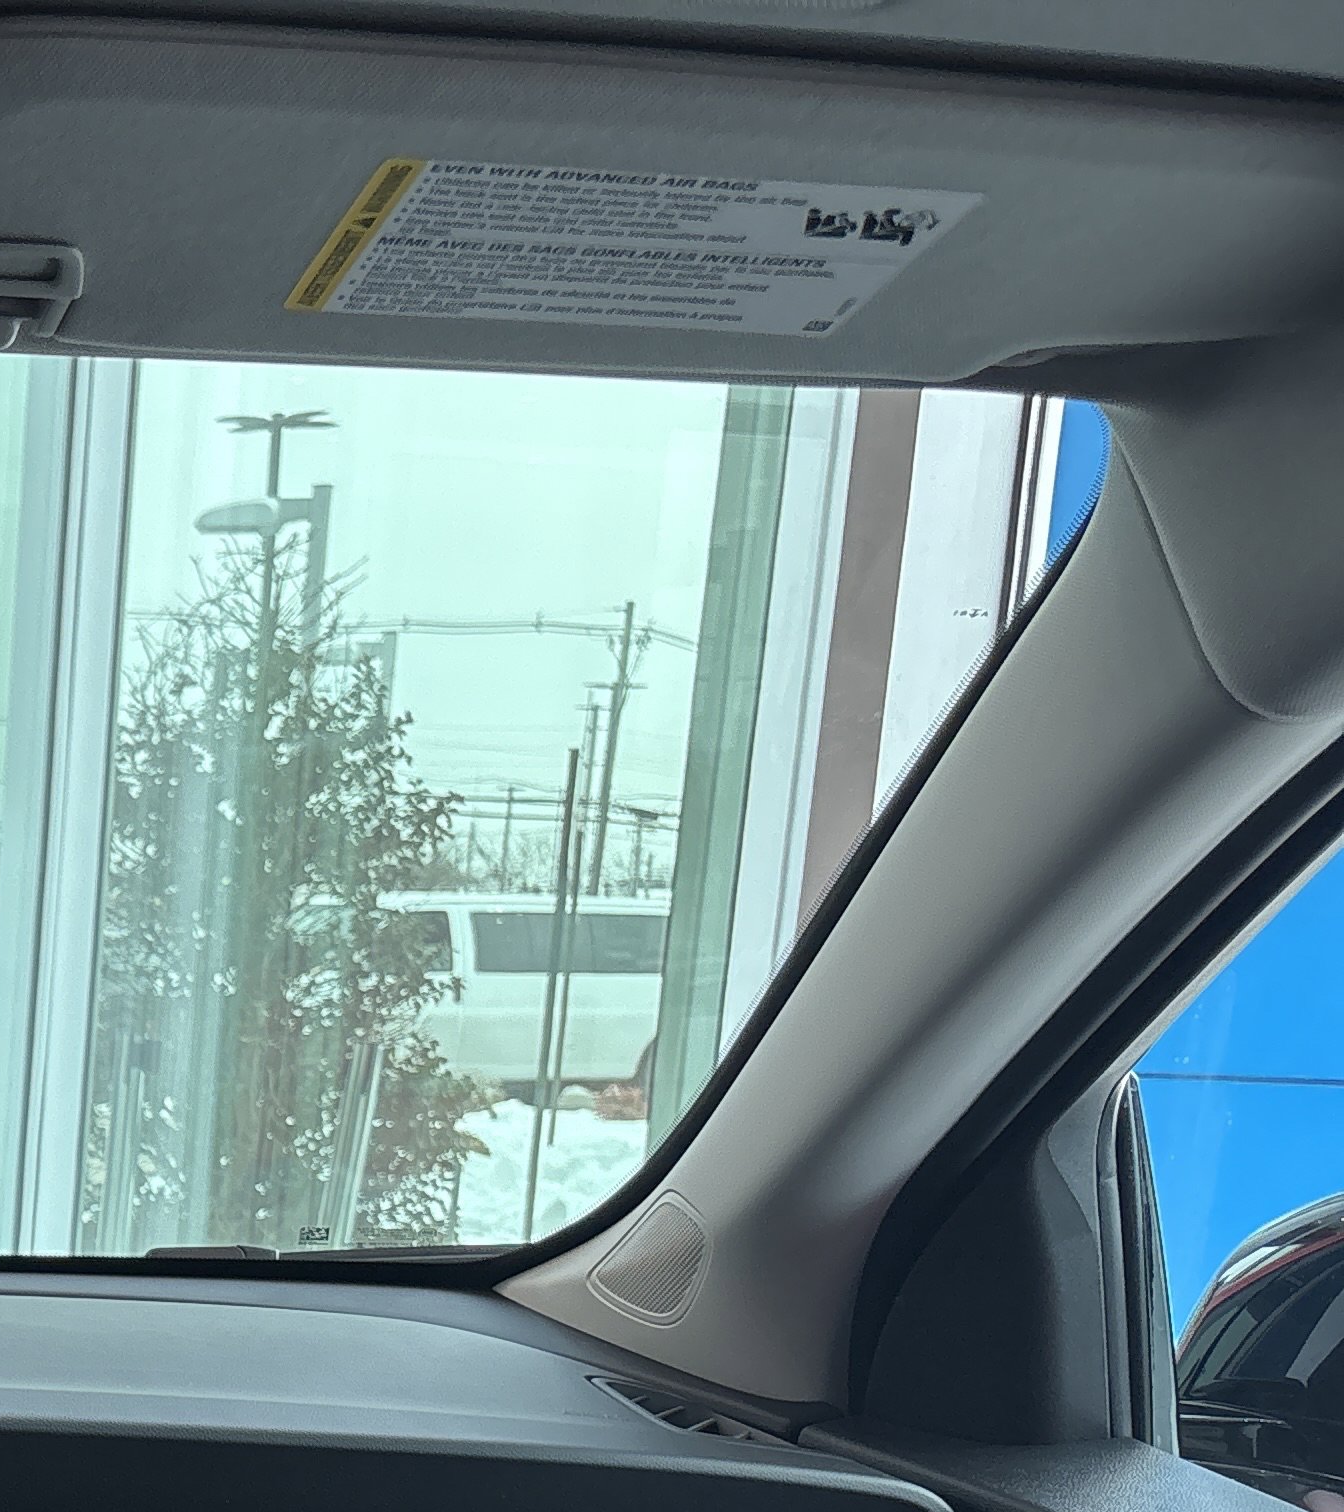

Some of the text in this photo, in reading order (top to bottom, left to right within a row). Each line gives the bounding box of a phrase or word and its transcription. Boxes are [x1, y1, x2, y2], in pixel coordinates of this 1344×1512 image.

[430, 164, 758, 191] EVEN WITH ADVANCED AIR BAGS
[436, 240, 486, 251] AVEC
[699, 253, 827, 268] INTELLIGENTS
